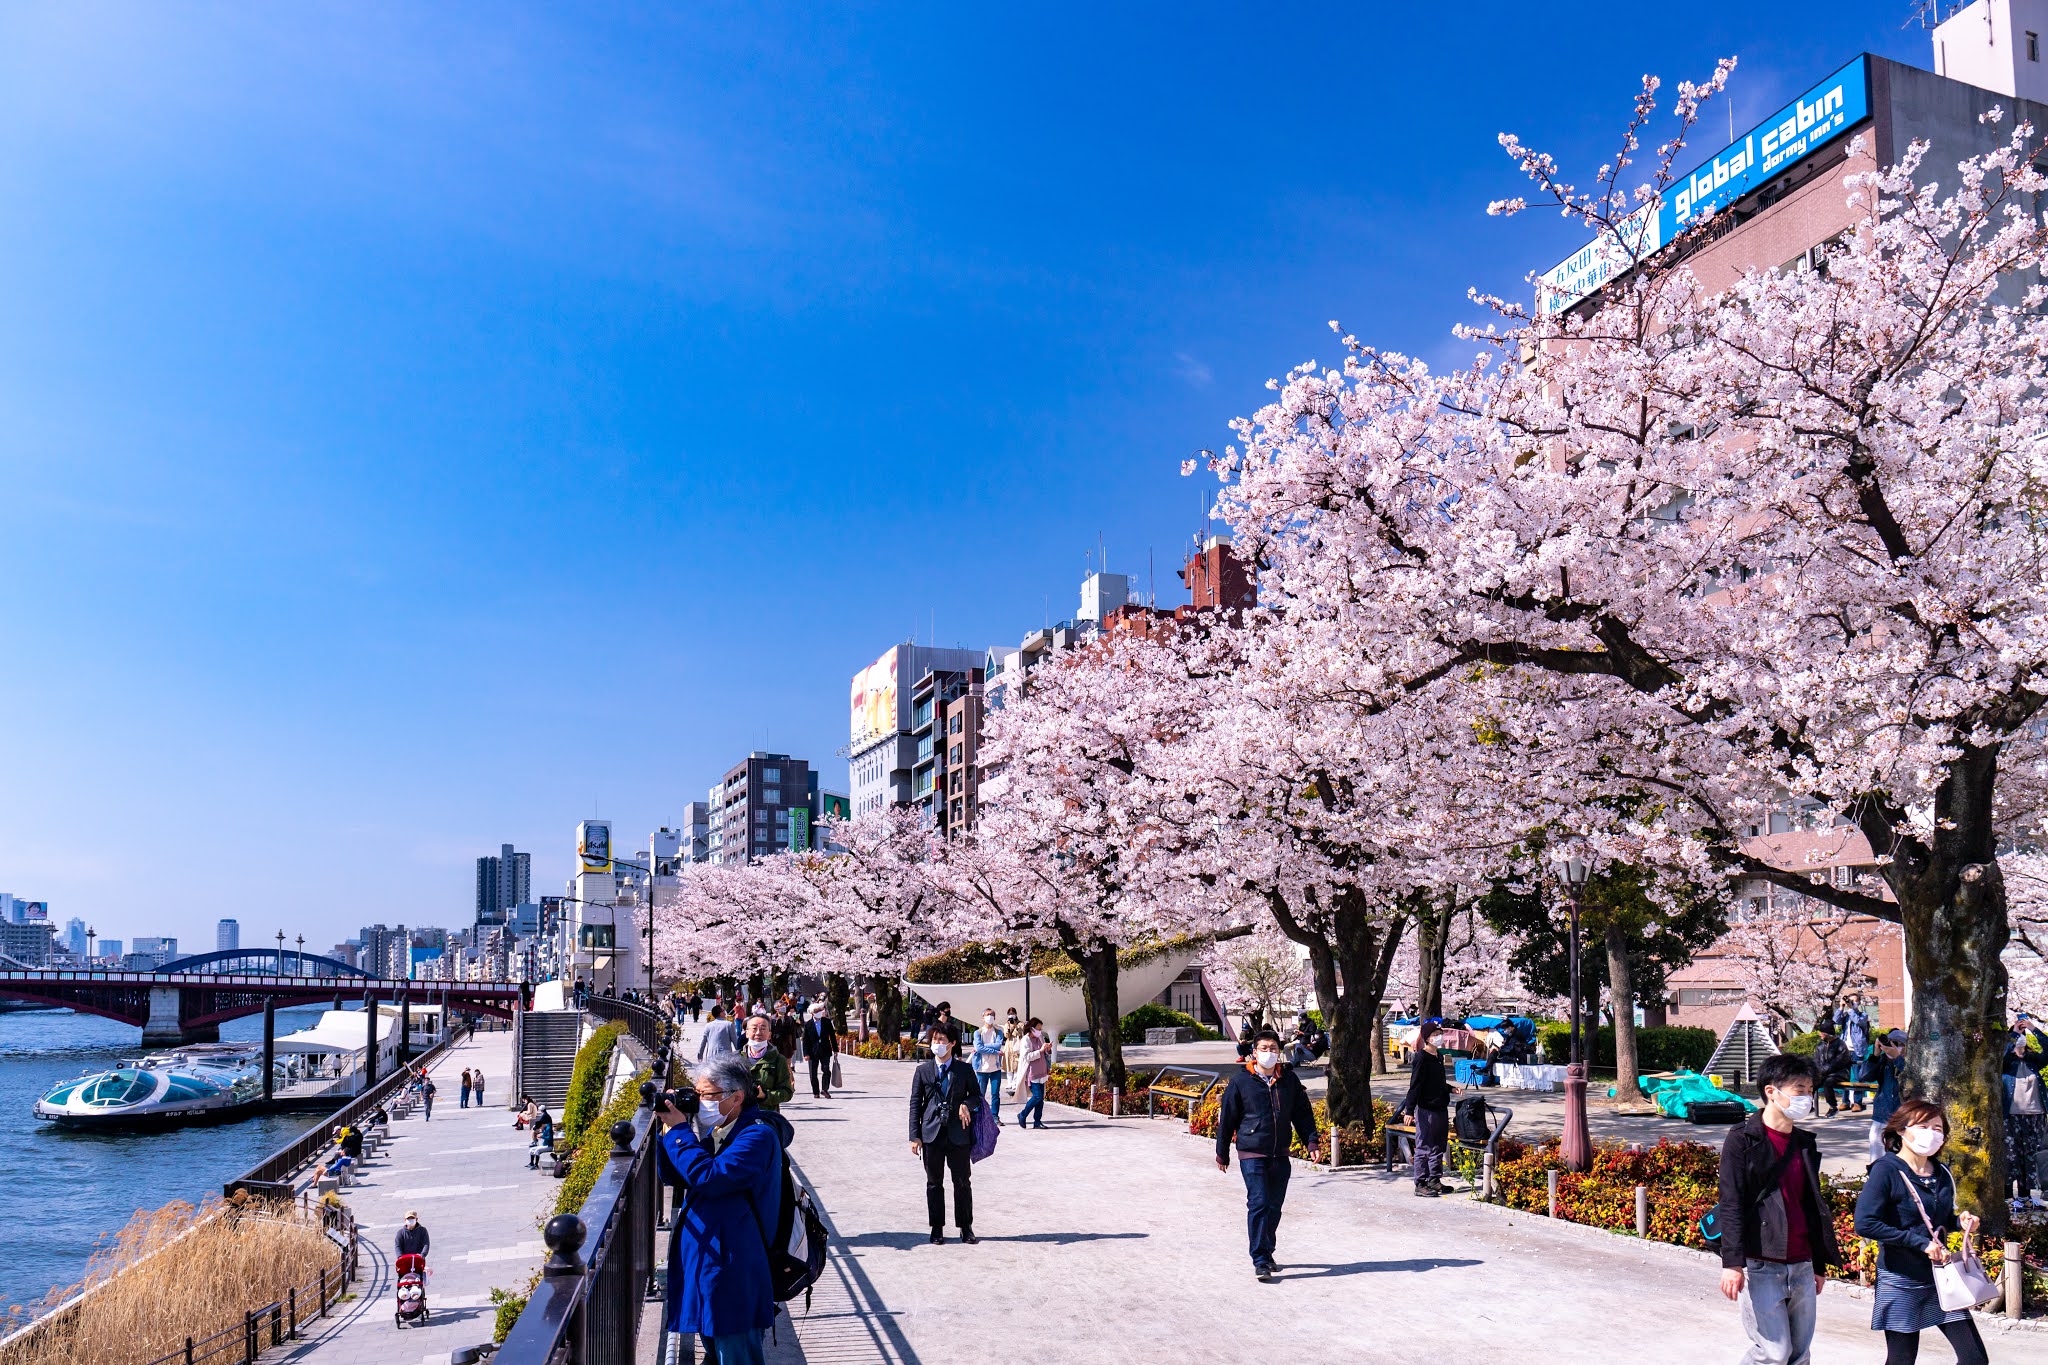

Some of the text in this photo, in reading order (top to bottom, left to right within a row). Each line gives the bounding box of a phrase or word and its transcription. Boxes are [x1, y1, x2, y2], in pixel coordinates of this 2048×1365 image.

[1675, 84, 1844, 225] global cabin
[1762, 136, 1807, 174] dormy
